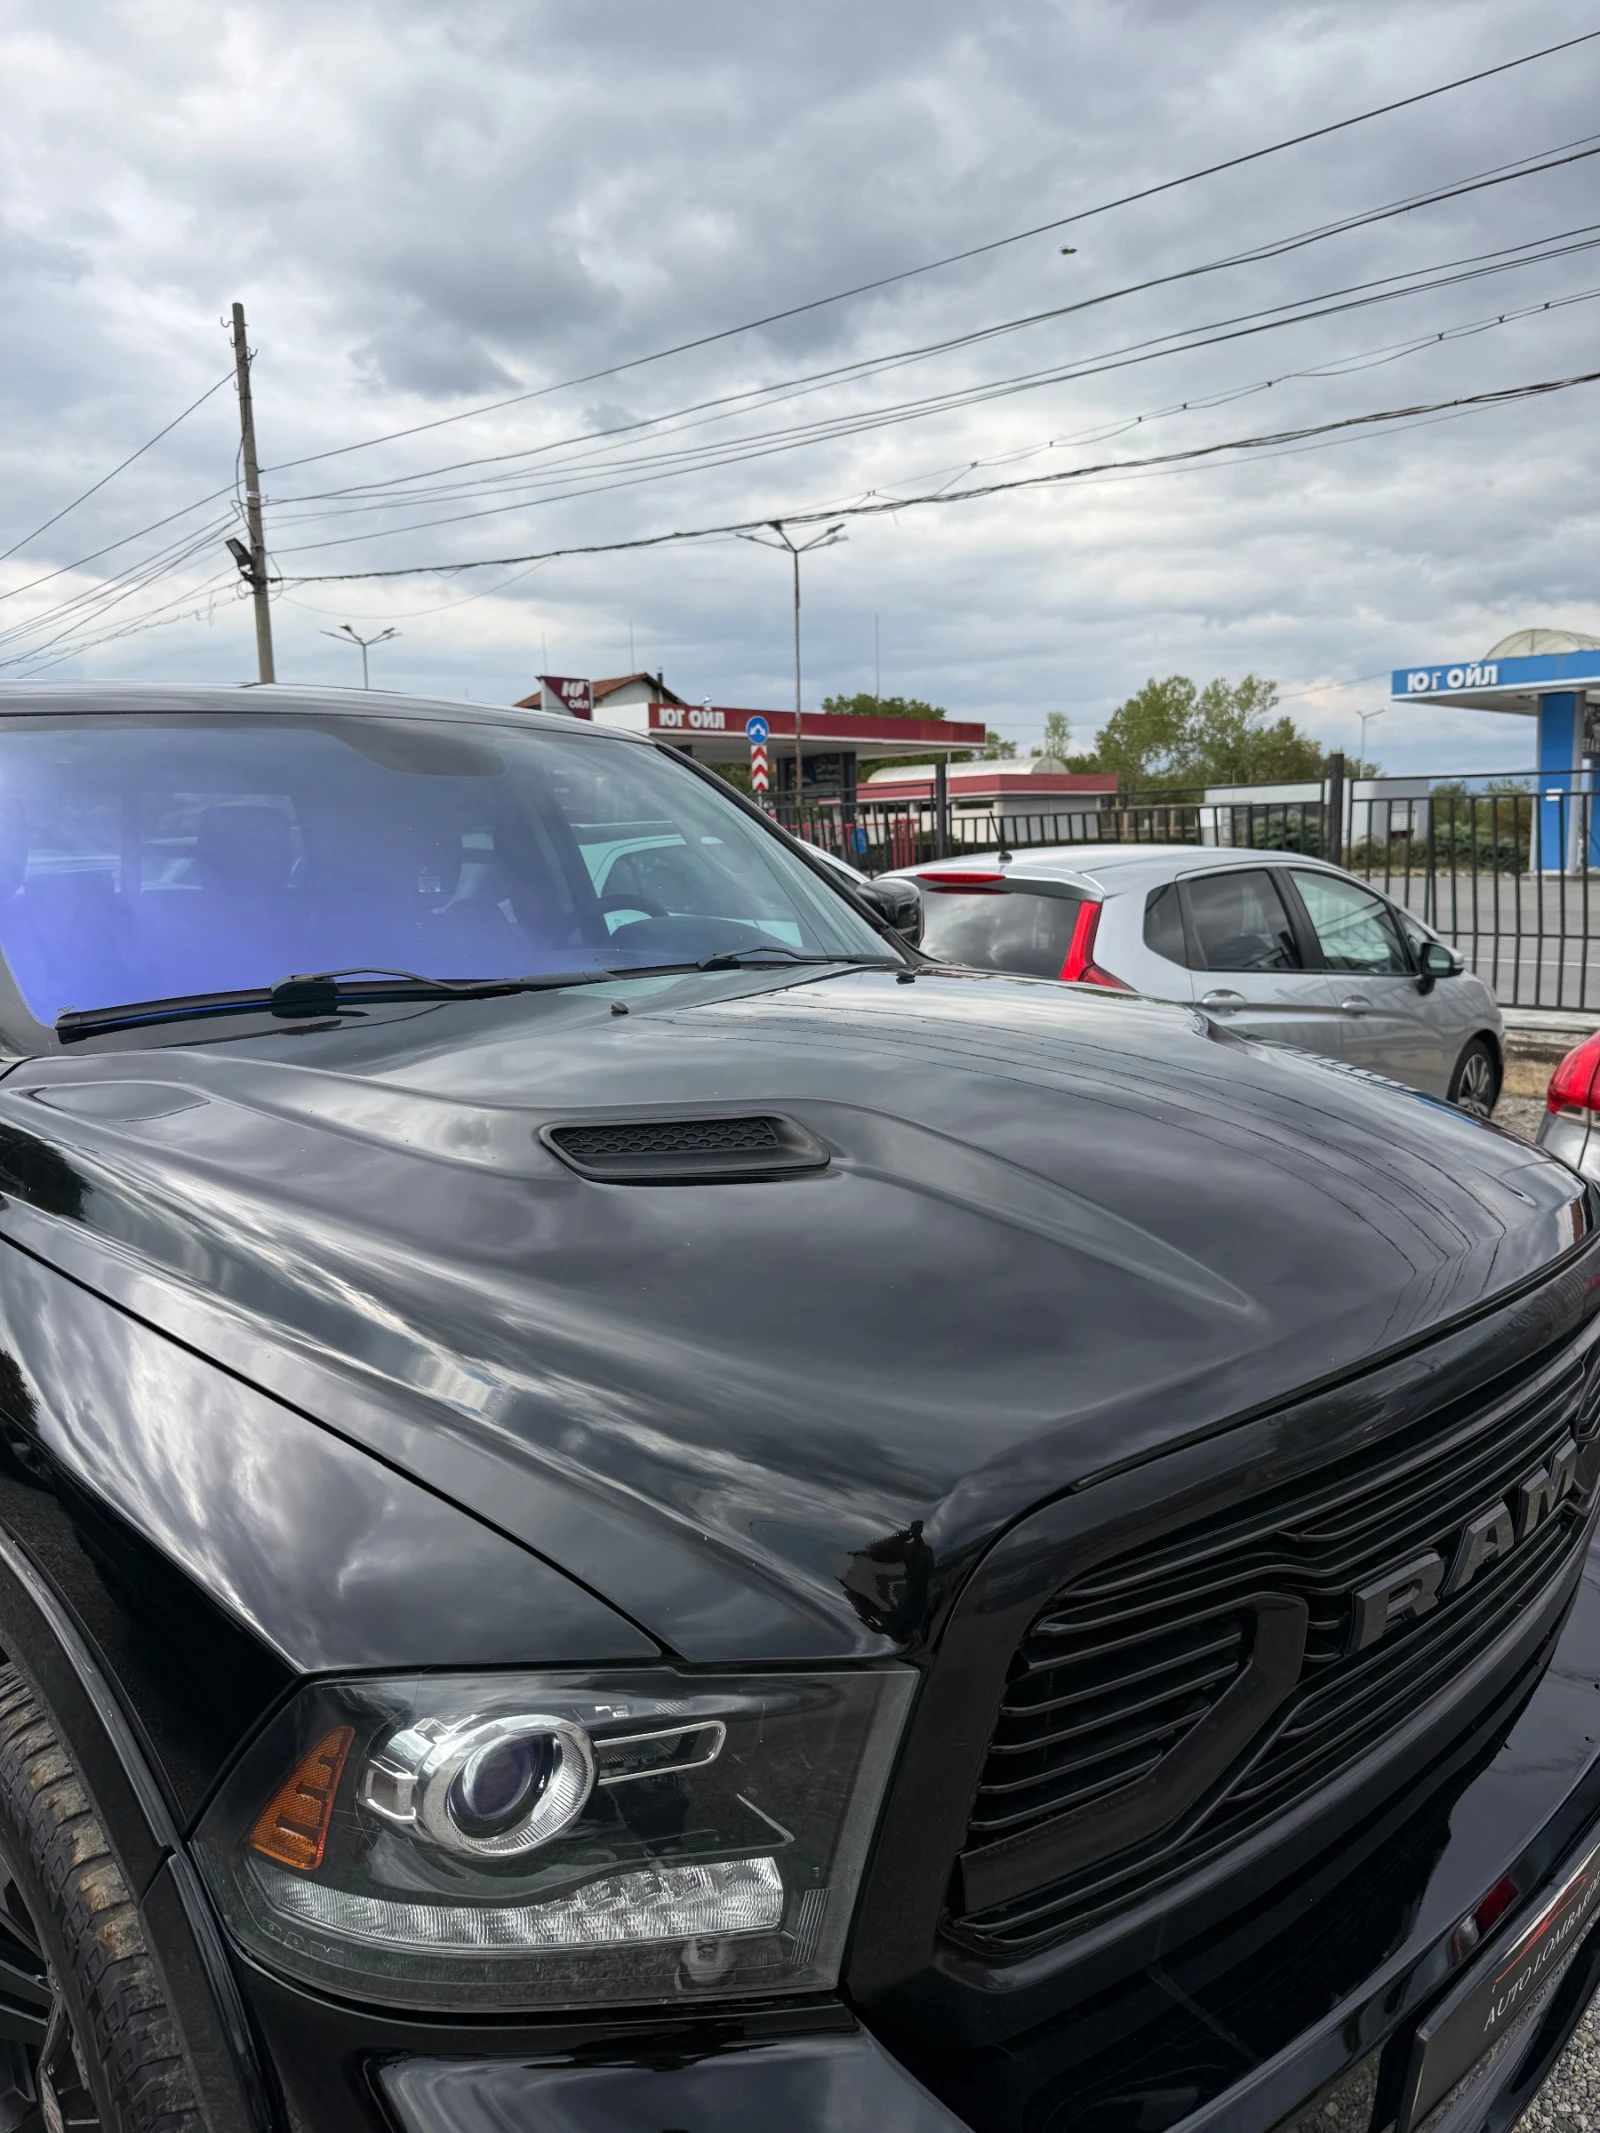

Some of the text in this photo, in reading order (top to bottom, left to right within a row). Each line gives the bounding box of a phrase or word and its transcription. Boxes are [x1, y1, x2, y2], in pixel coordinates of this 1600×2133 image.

[1407, 663, 1498, 692] ЮГ ОЙЛ
[659, 707, 725, 729] ЮГ ОЙЛ
[1346, 1436, 1578, 1655] RAM
